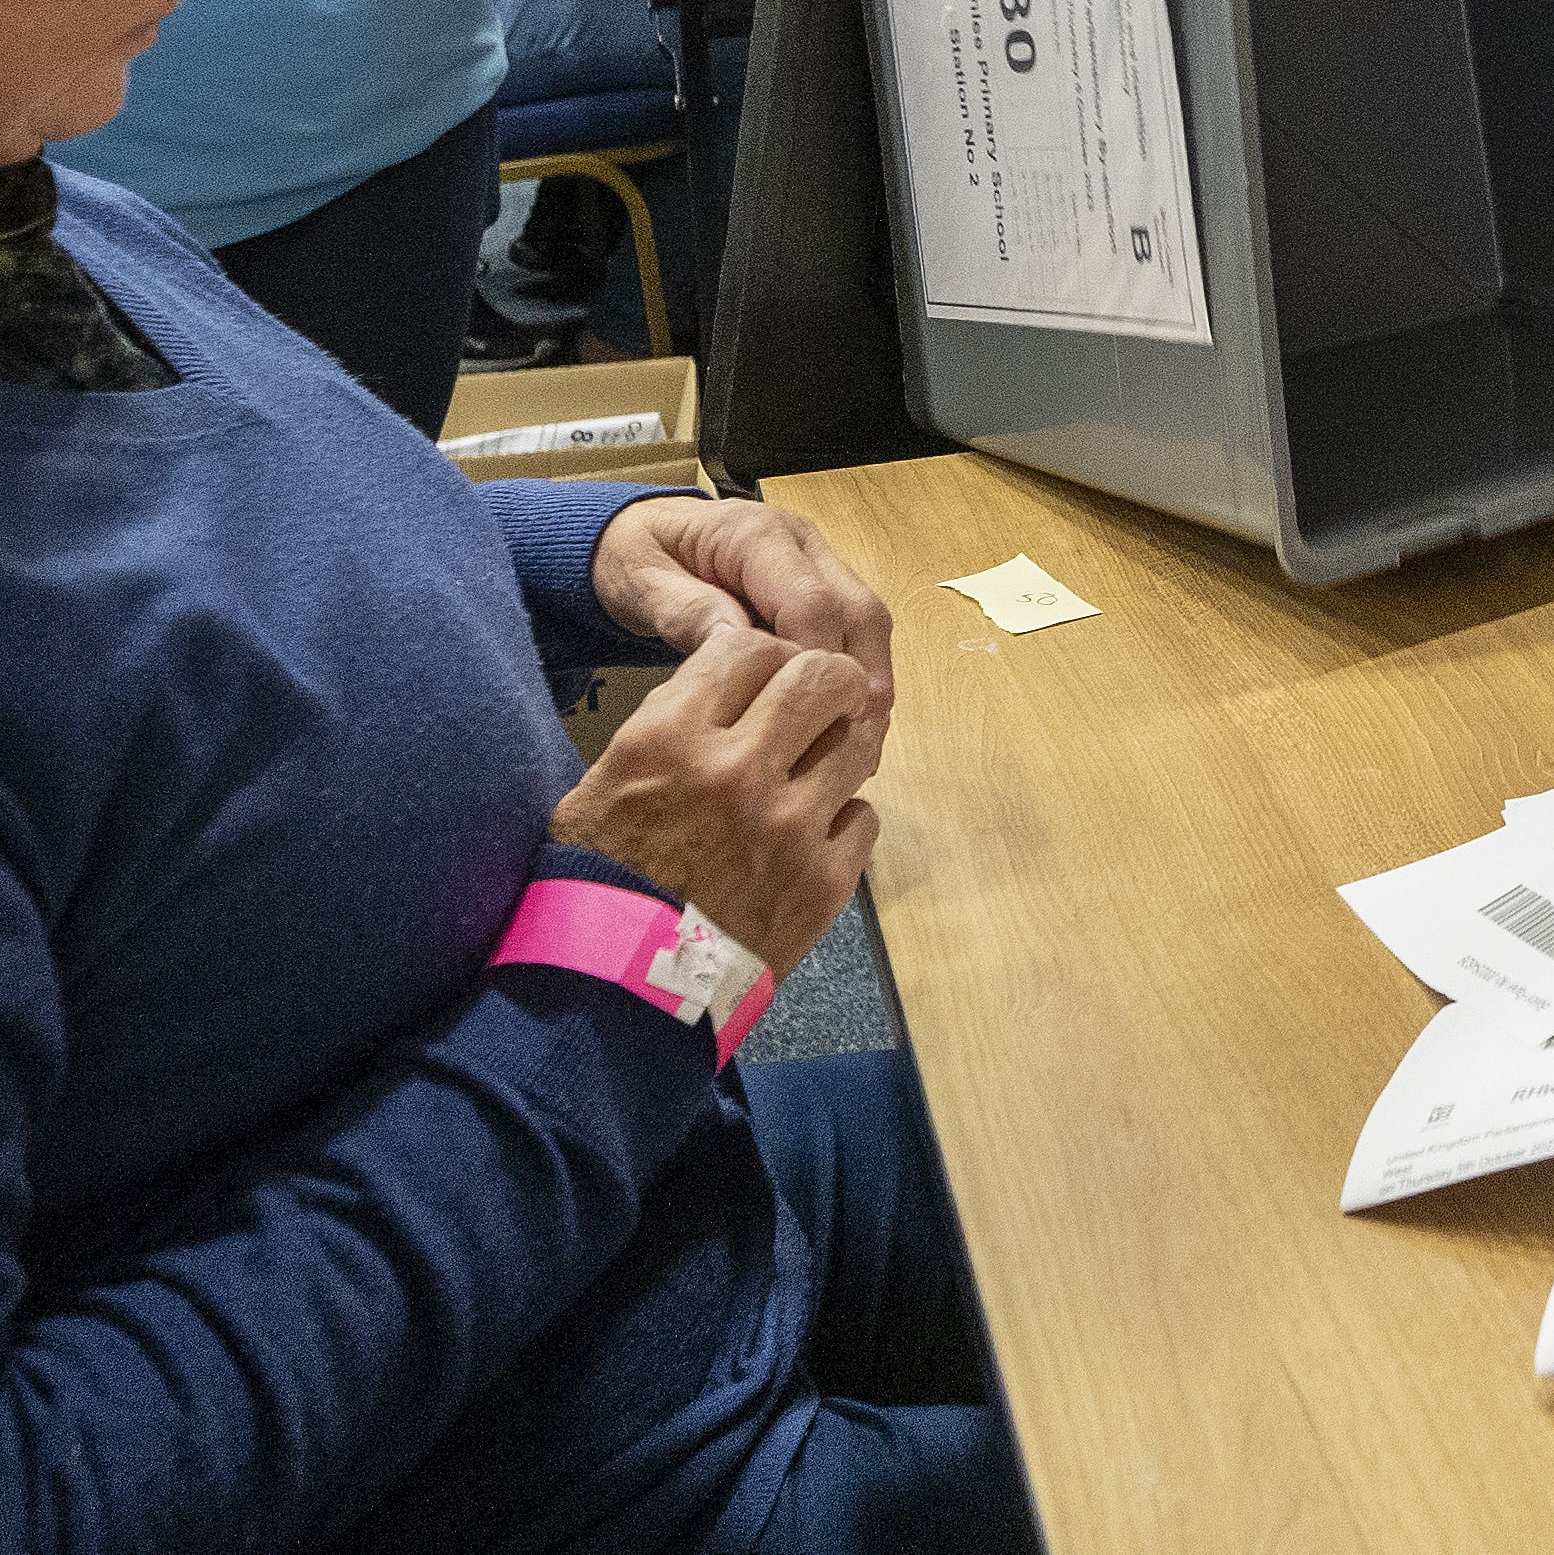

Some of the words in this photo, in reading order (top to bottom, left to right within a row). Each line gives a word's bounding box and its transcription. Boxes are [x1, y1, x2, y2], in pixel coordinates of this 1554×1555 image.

[948, 28, 972, 119] Station
[962, 128, 978, 164] No
[974, 60, 1000, 162] Primary
[988, 170, 1012, 263] School
[968, 173, 980, 187] 2
[1128, 225, 1153, 265] B
